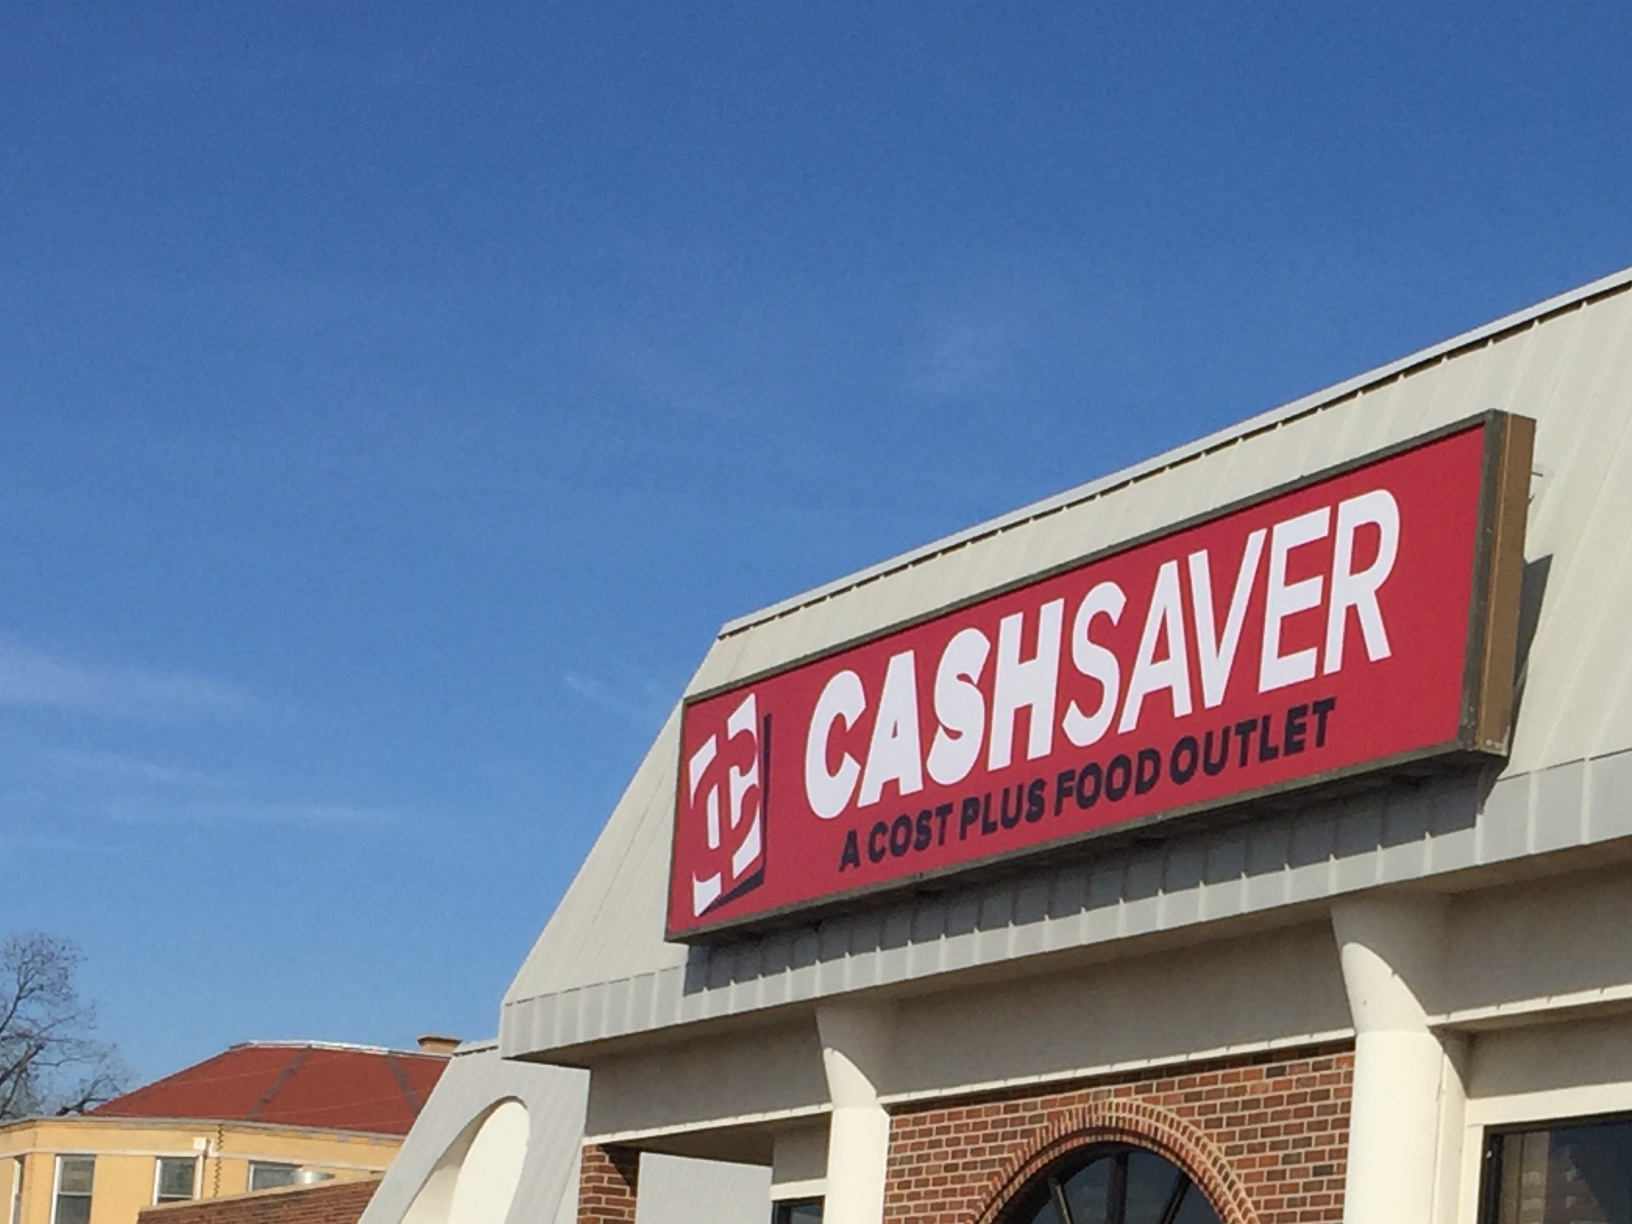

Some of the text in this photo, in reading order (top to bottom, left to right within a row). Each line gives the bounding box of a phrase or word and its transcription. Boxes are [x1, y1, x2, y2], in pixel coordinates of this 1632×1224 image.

[804, 488, 1401, 820] CASHSAVER
[838, 697, 1337, 873] A COST PLUS FOOD OUTLET
